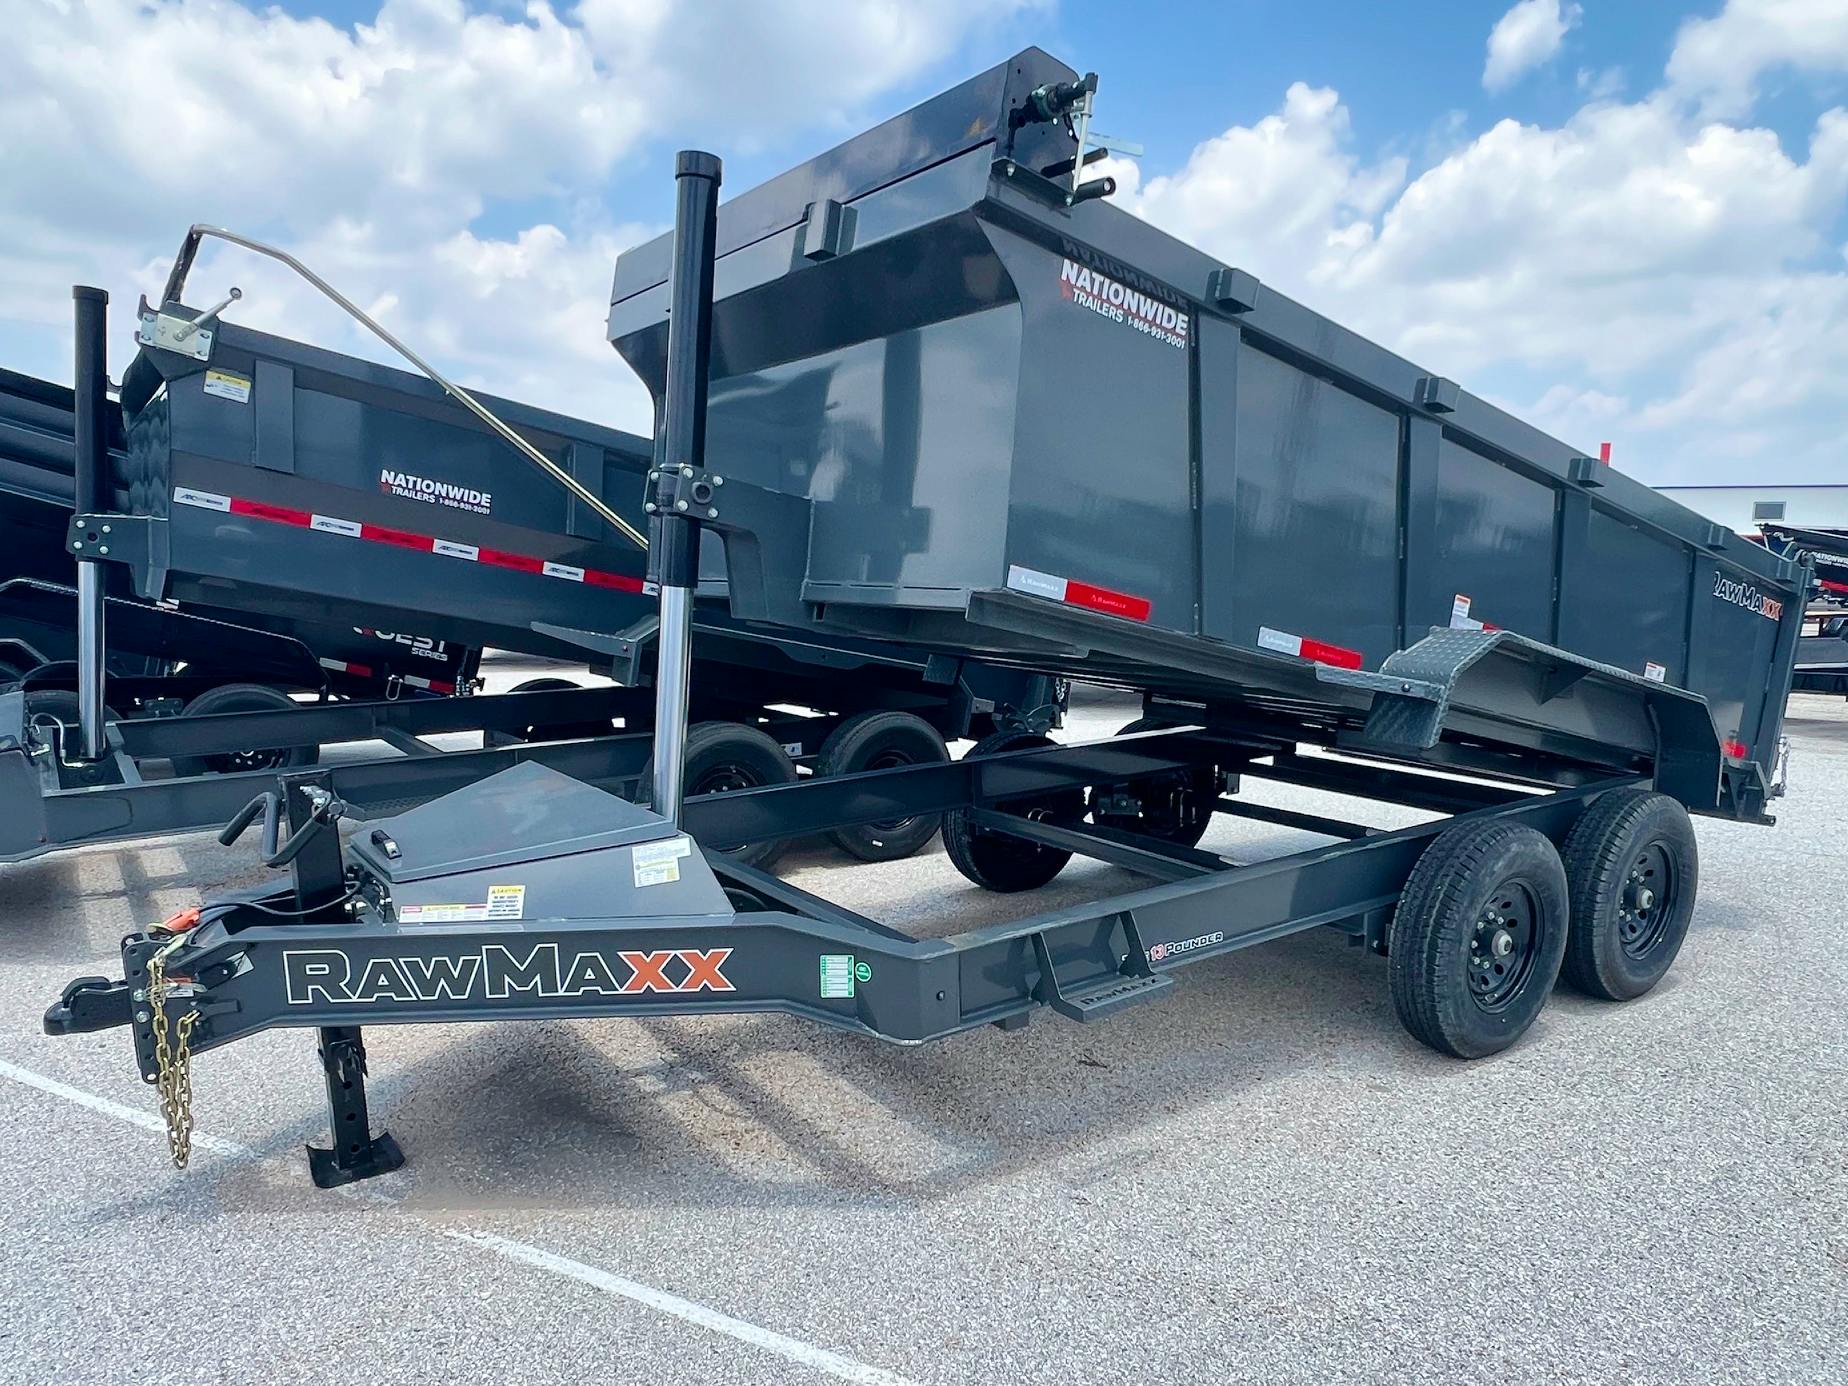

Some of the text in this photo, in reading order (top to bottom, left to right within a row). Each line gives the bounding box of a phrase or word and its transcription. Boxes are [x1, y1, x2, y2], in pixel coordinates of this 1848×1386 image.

[1061, 258, 1189, 336] NATIONWIDE
[1073, 288, 1186, 350] TRAILERS 1-866-931-3001
[381, 469, 492, 507] NATIONWIDE
[391, 486, 436, 504] TRAILERS
[411, 647, 448, 662] SERIES
[1165, 931, 1224, 957] POUNDER
